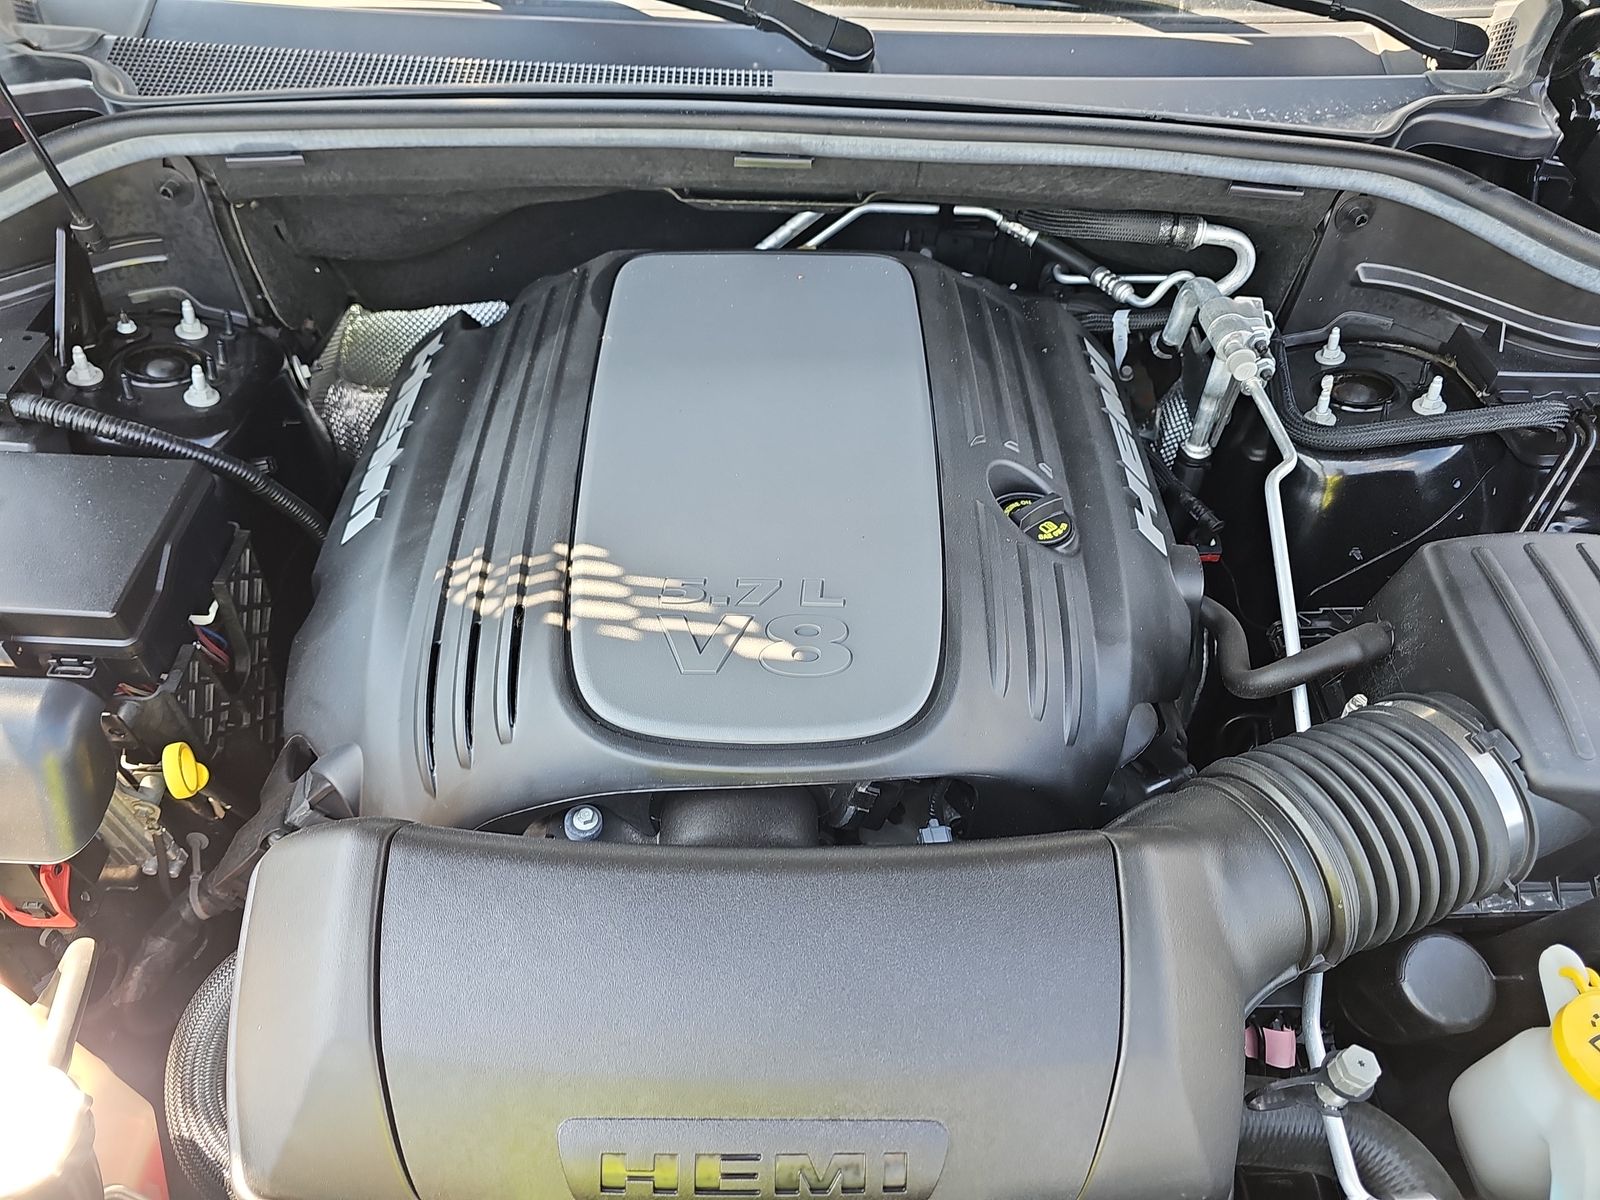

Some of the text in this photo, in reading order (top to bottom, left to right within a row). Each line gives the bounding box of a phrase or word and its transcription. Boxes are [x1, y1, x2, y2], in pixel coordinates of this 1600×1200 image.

[340, 332, 444, 545] HEMI
[1083, 337, 1168, 557] HEMI
[656, 613, 854, 678] V8
[599, 1152, 908, 1195] HEMI
